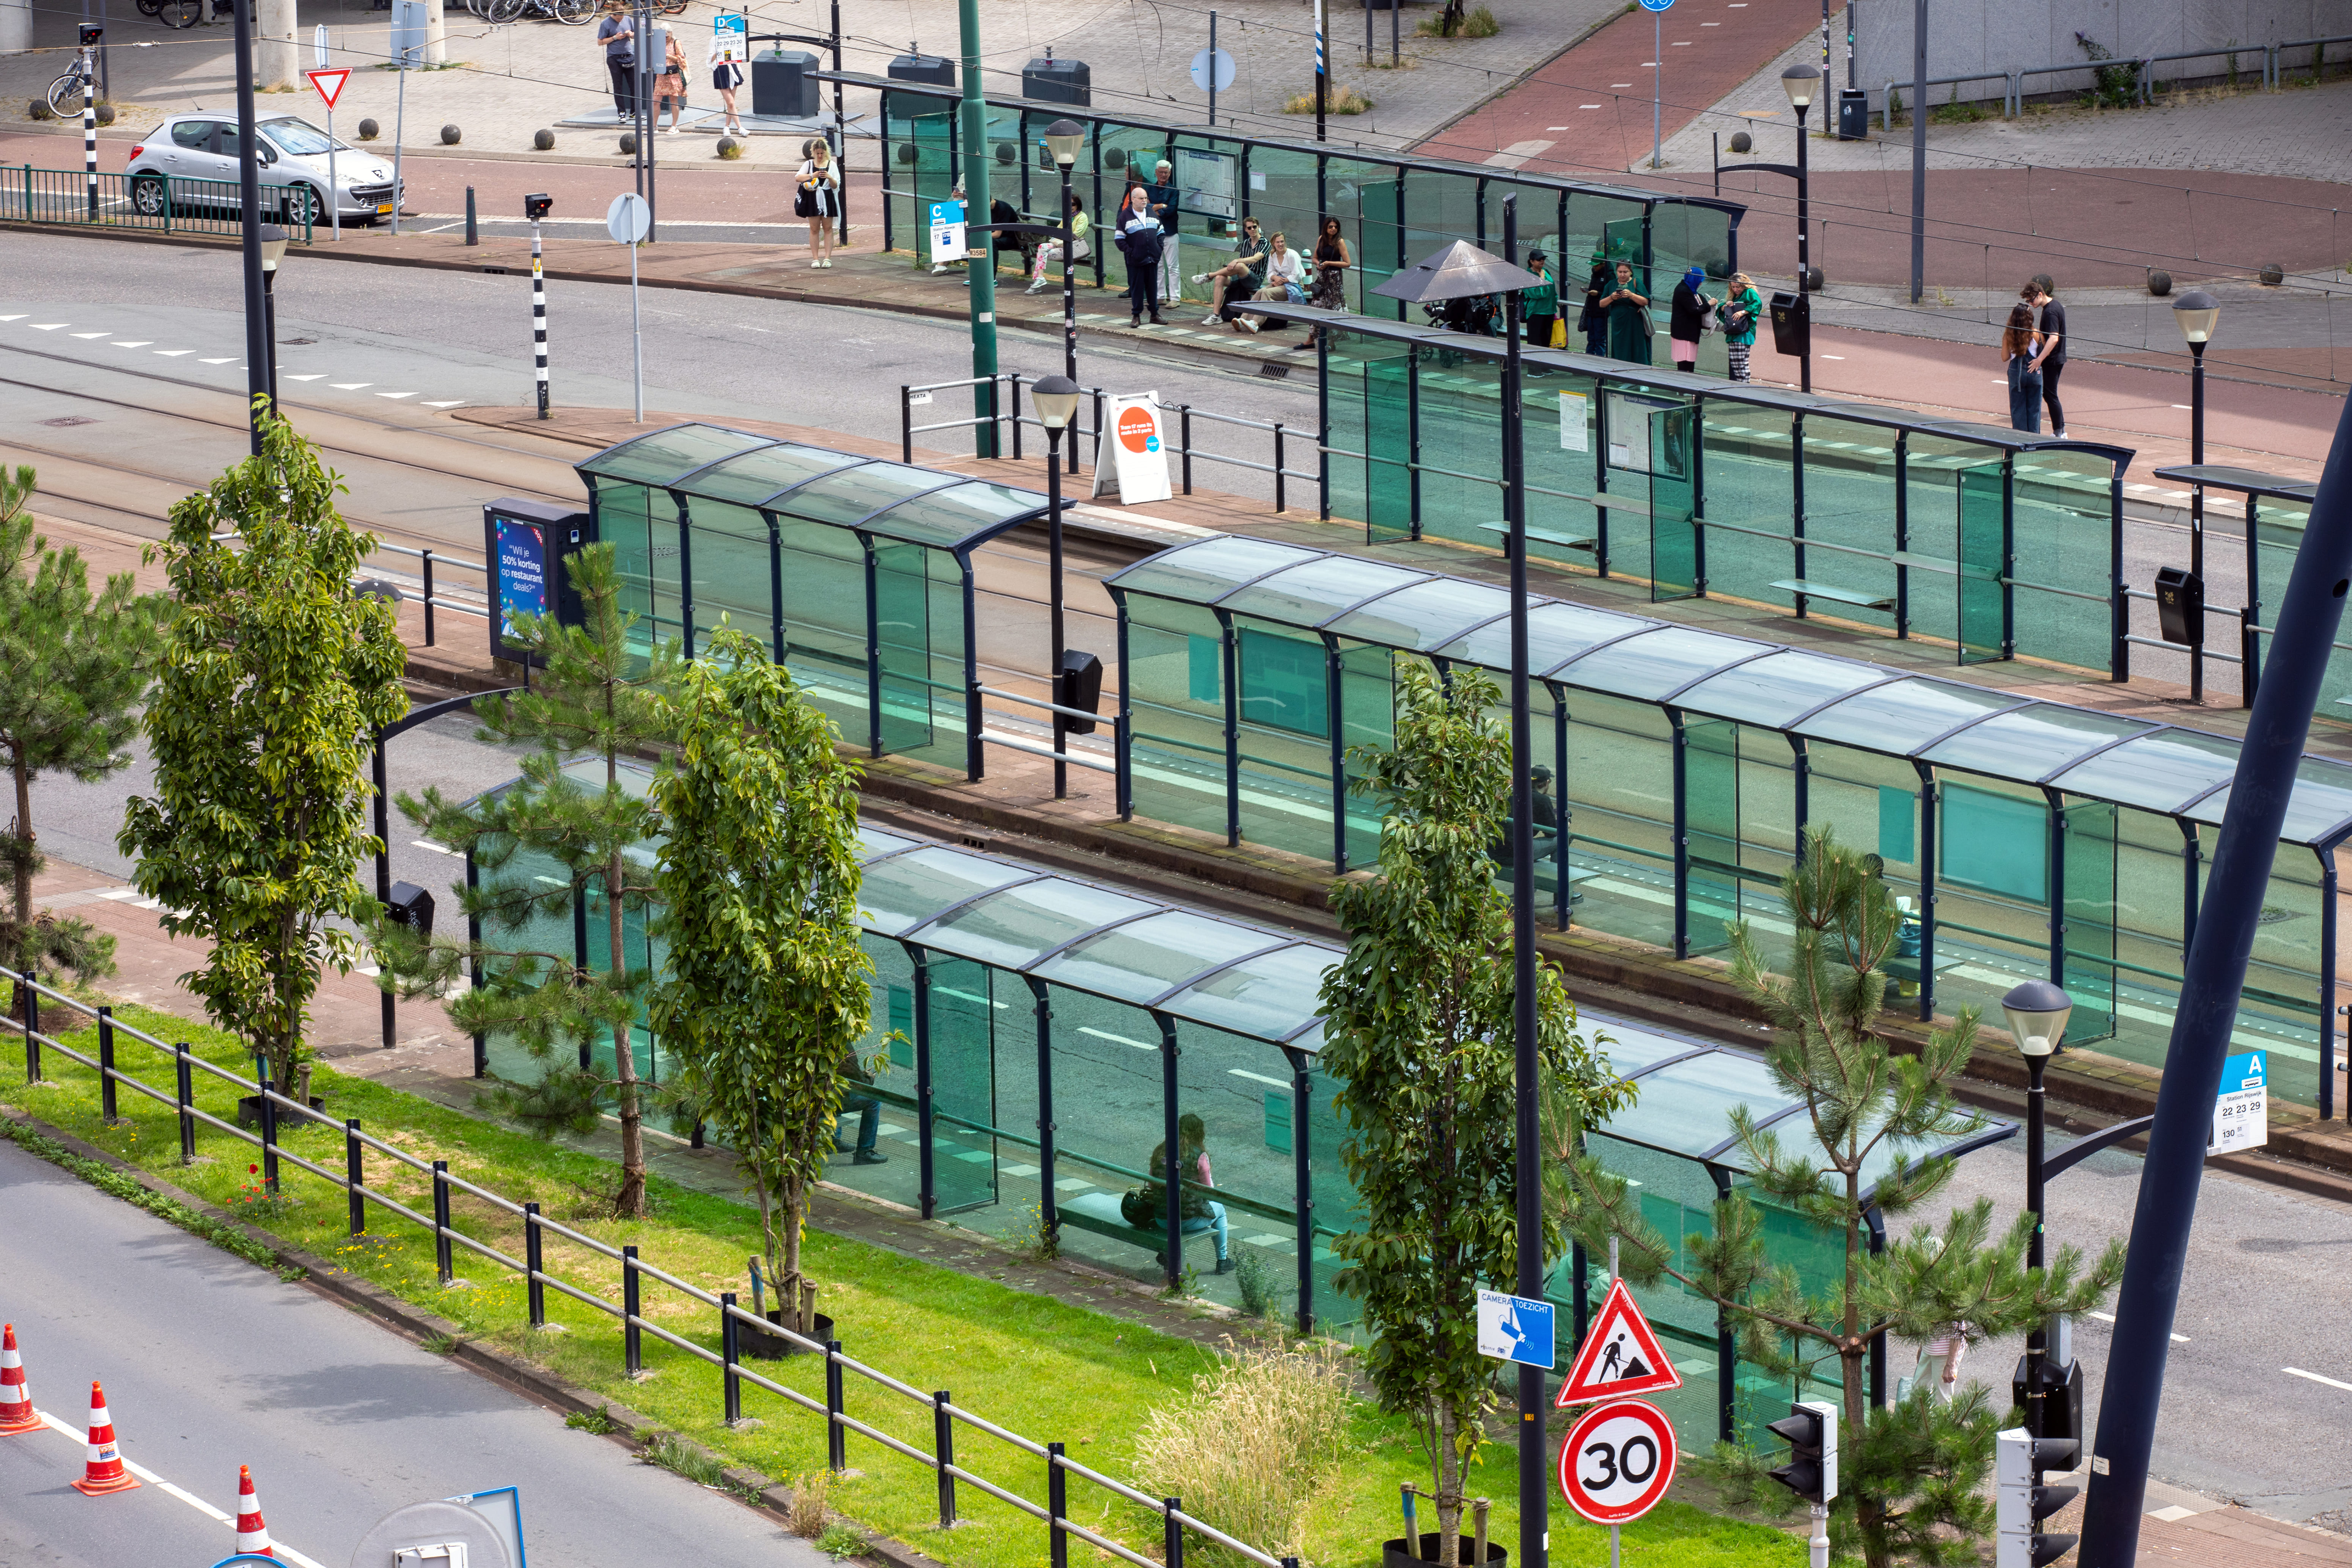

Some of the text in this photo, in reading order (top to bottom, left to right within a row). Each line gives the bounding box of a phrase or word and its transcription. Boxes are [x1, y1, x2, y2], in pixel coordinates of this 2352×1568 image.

[717, 17, 725, 27] D
[932, 205, 942, 217] C
[524, 547, 529, 558] je
[502, 555, 540, 573] 50% korting
[501, 569, 542, 584] op restaurant
[2248, 1055, 2262, 1075] A
[2244, 1090, 2262, 1099] Rijswijk
[2223, 1107, 2233, 1116] 22
[2236, 1105, 2246, 1113] 23
[2250, 1101, 2260, 1111] 29
[2223, 1130, 2235, 1138] 130
[1482, 1293, 1549, 1314] CAMERA TOEZICHT
[1582, 1436, 1657, 1491] 30
[1811, 1505, 1821, 1515] 2.1
